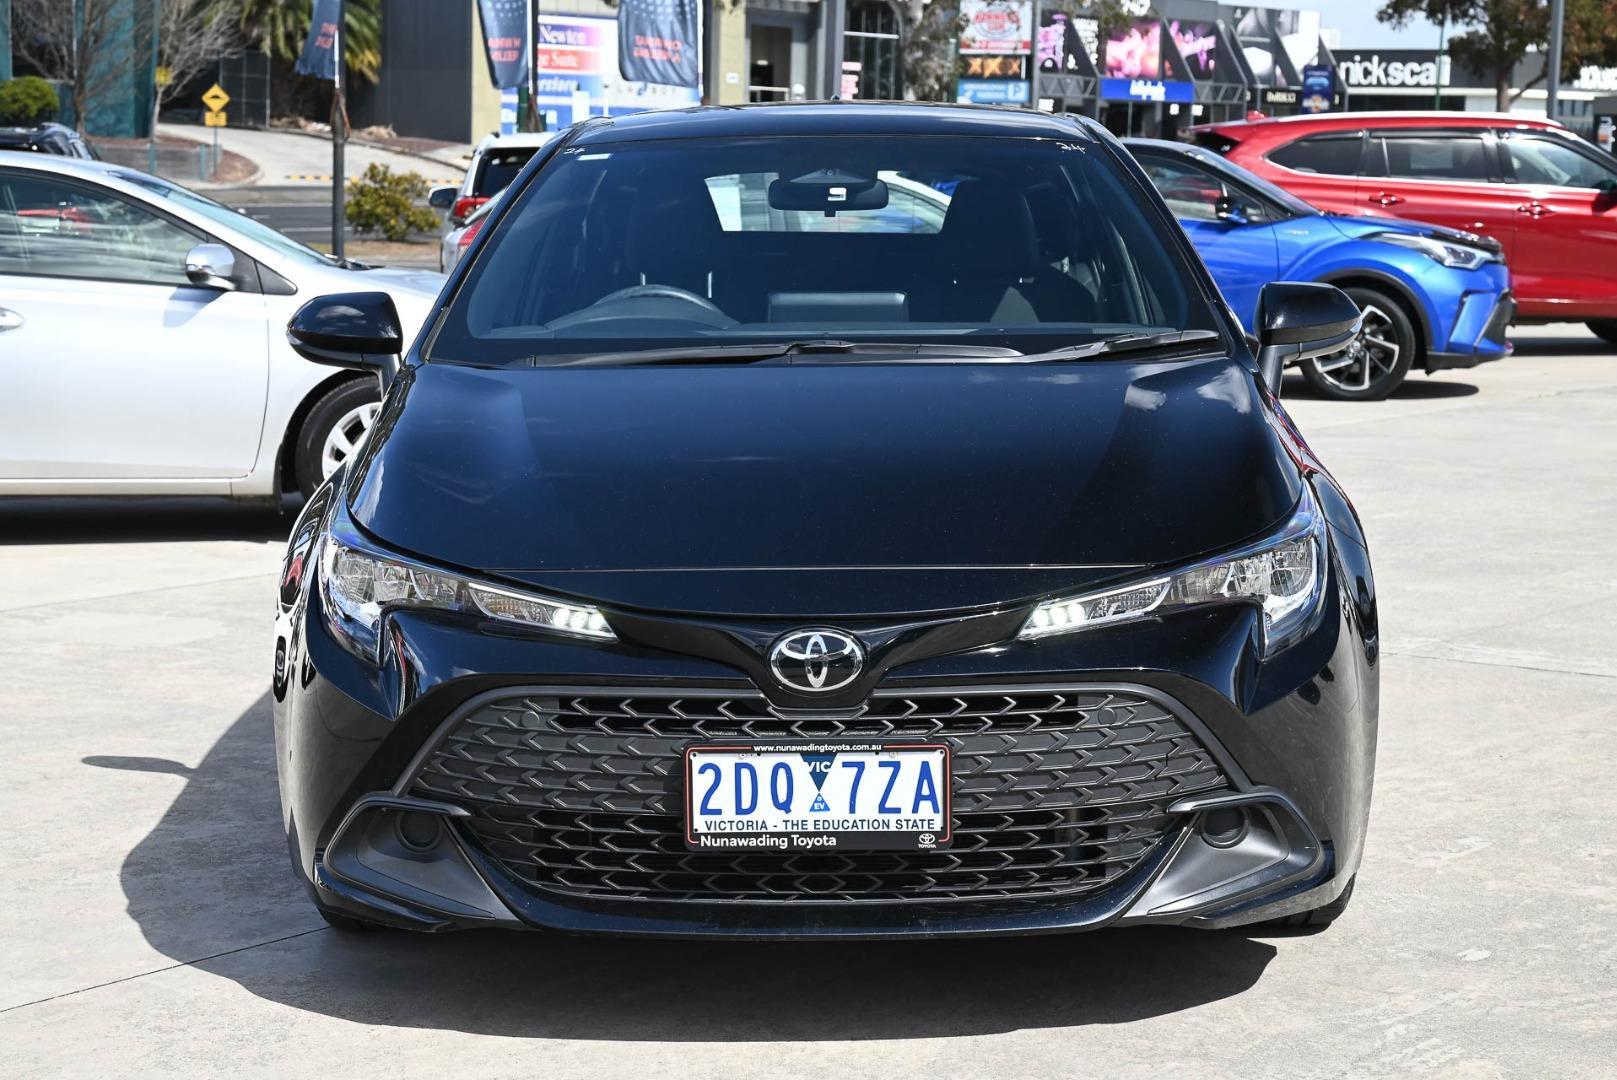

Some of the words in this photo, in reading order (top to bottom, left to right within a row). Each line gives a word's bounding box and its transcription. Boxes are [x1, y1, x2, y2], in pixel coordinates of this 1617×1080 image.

[753, 743, 882, 753] www.nunawadingtoyota.com.au
[803, 761, 832, 773] VIC
[698, 761, 794, 816] 2DQ
[841, 760, 941, 815] 7ZA
[813, 802, 825, 810] EV
[704, 820, 768, 831] VICTORIA
[782, 819, 809, 831] THE
[813, 818, 893, 830] EDUCATION
[895, 818, 935, 830] STATE
[700, 834, 788, 849] Nunawading
[790, 834, 837, 849] Toyota
